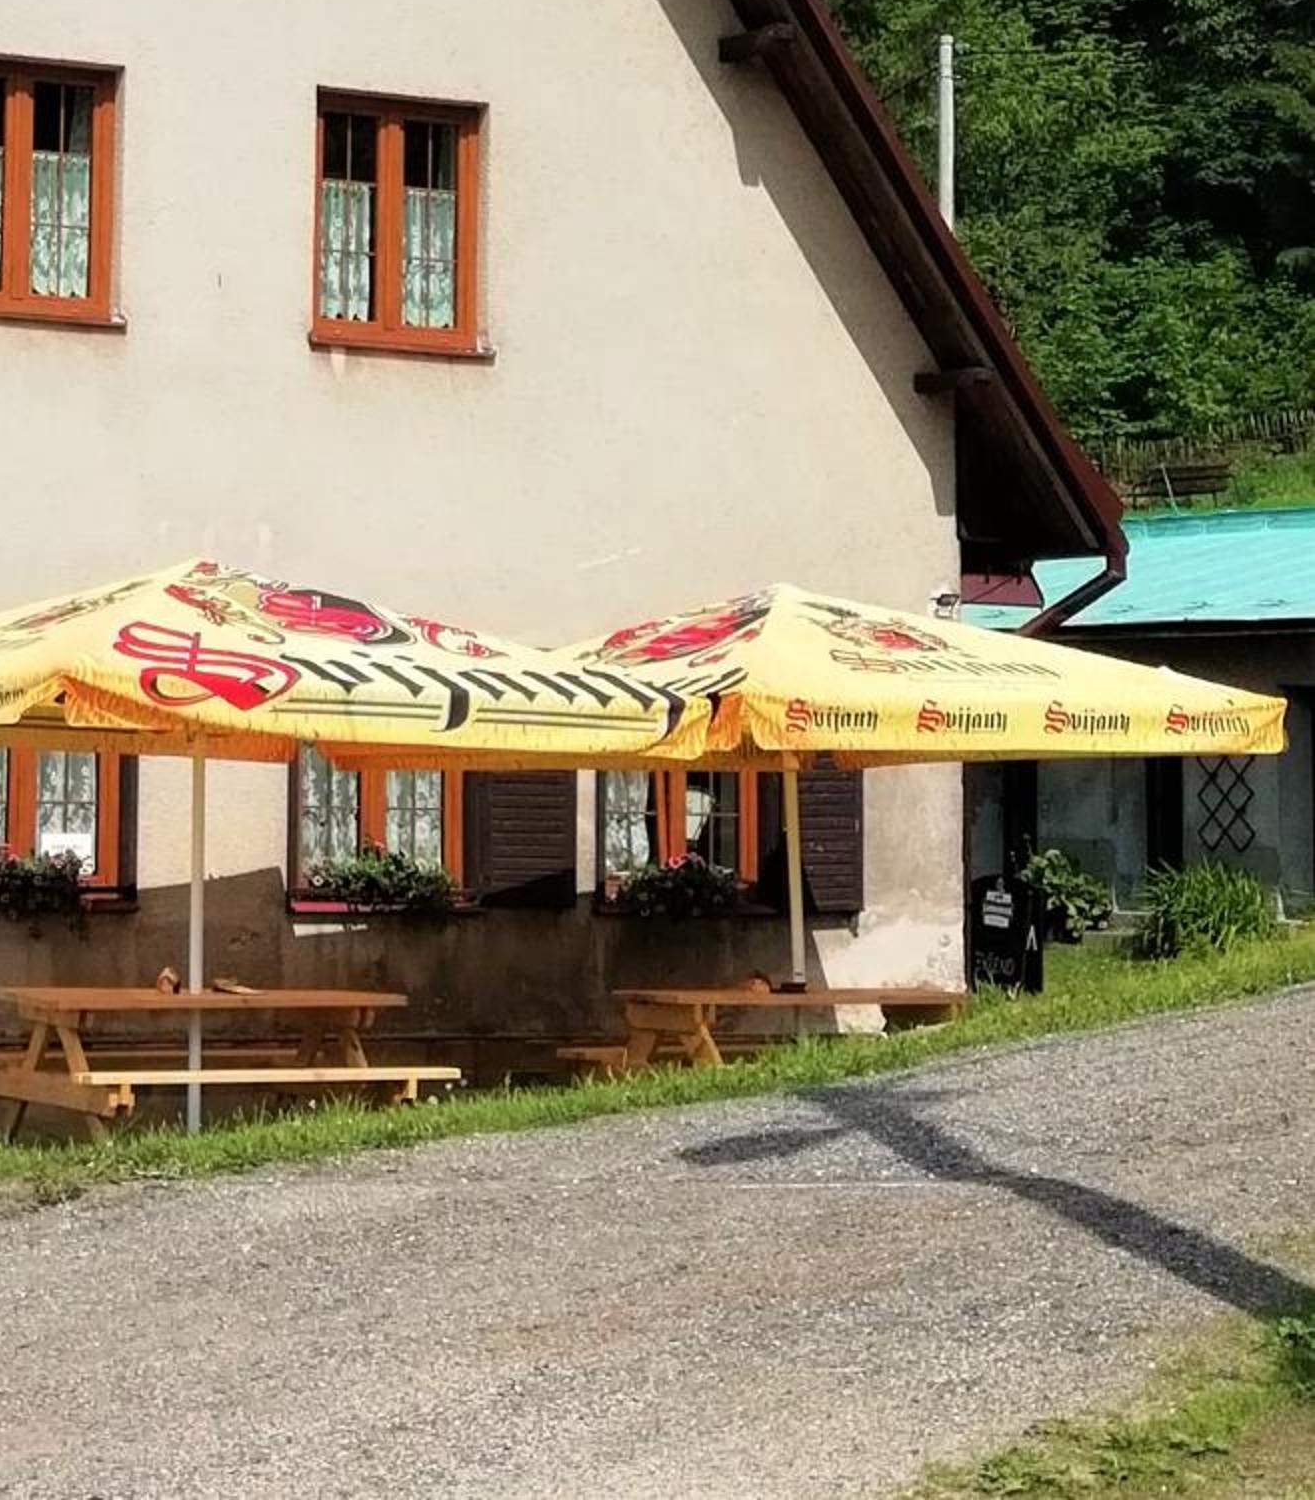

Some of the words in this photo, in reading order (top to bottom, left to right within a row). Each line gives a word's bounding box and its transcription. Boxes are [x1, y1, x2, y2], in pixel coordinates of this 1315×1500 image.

[112, 621, 685, 740] Svijany
[785, 697, 878, 733] Svijany
[916, 699, 1007, 733] Svijany
[1043, 700, 1130, 735] Svijany
[1164, 704, 1250, 737] Svijany
